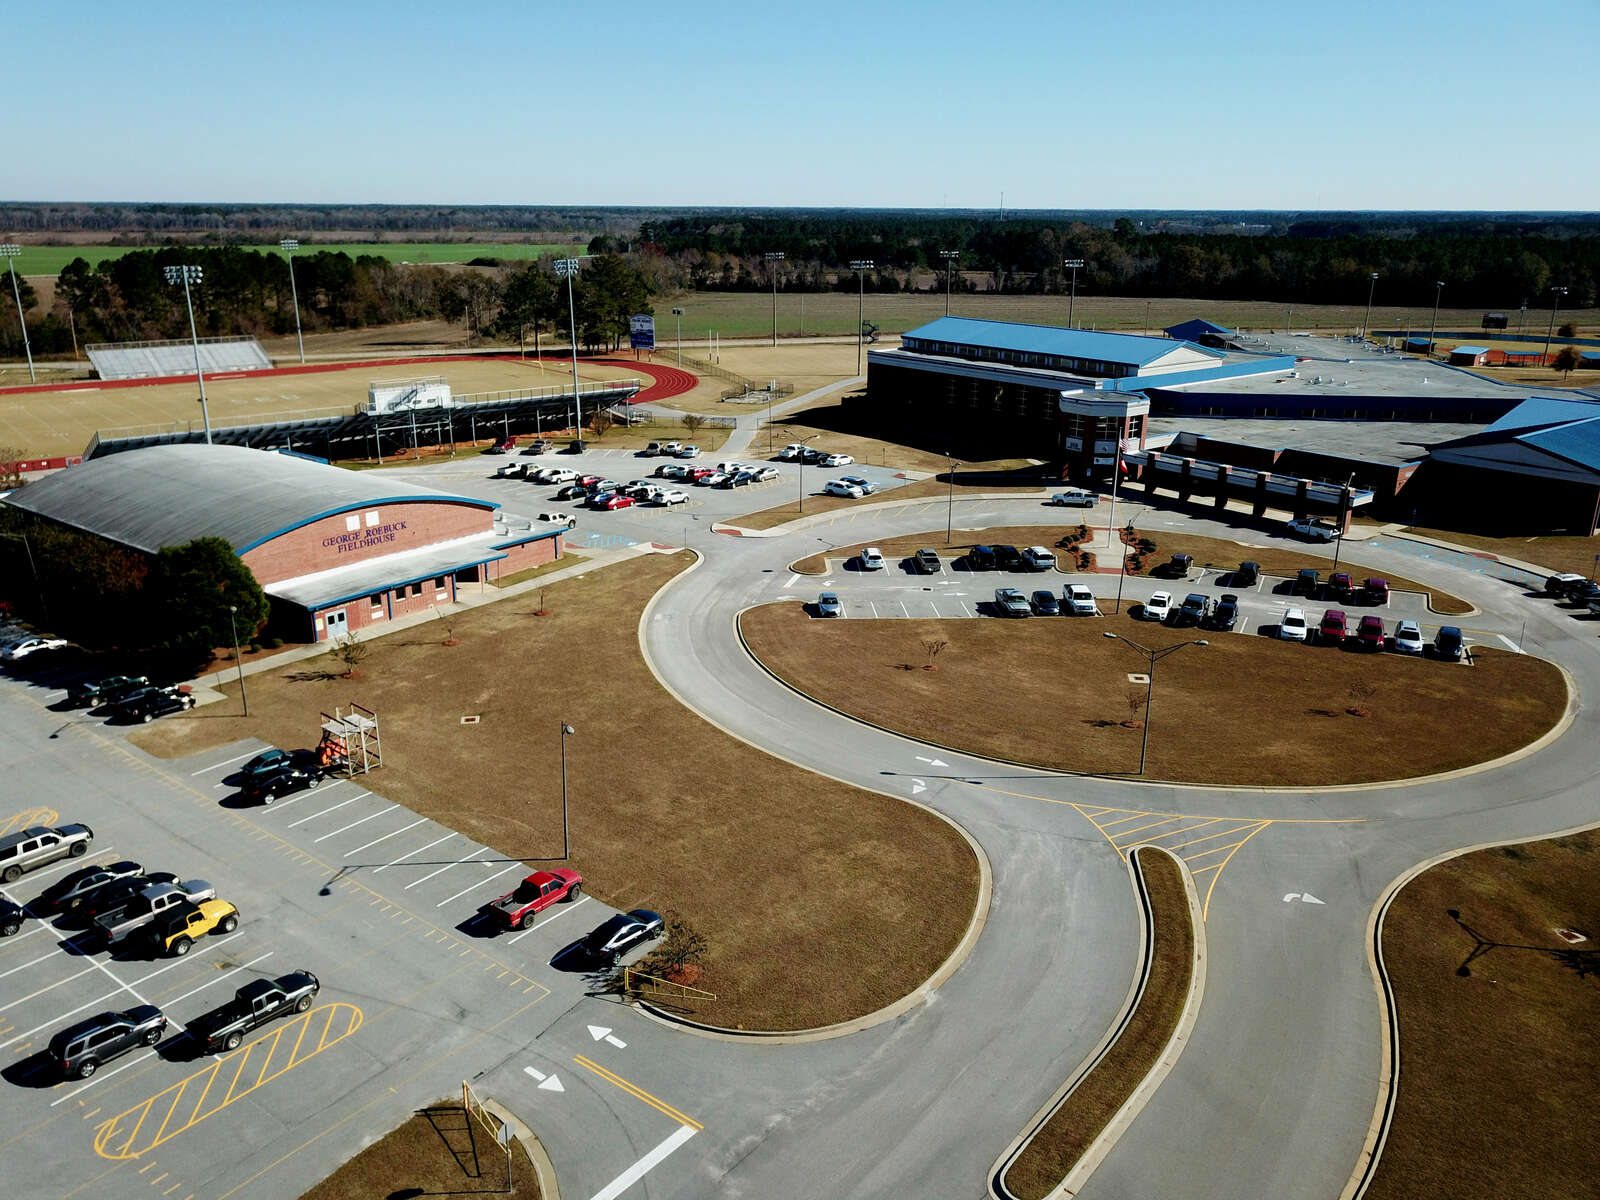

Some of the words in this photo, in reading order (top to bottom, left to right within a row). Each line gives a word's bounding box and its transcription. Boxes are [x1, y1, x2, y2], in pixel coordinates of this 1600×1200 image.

[322, 531, 360, 547] GEORGE
[364, 521, 406, 538] ROEBUCK
[338, 533, 395, 553] FIELDHOUSE
